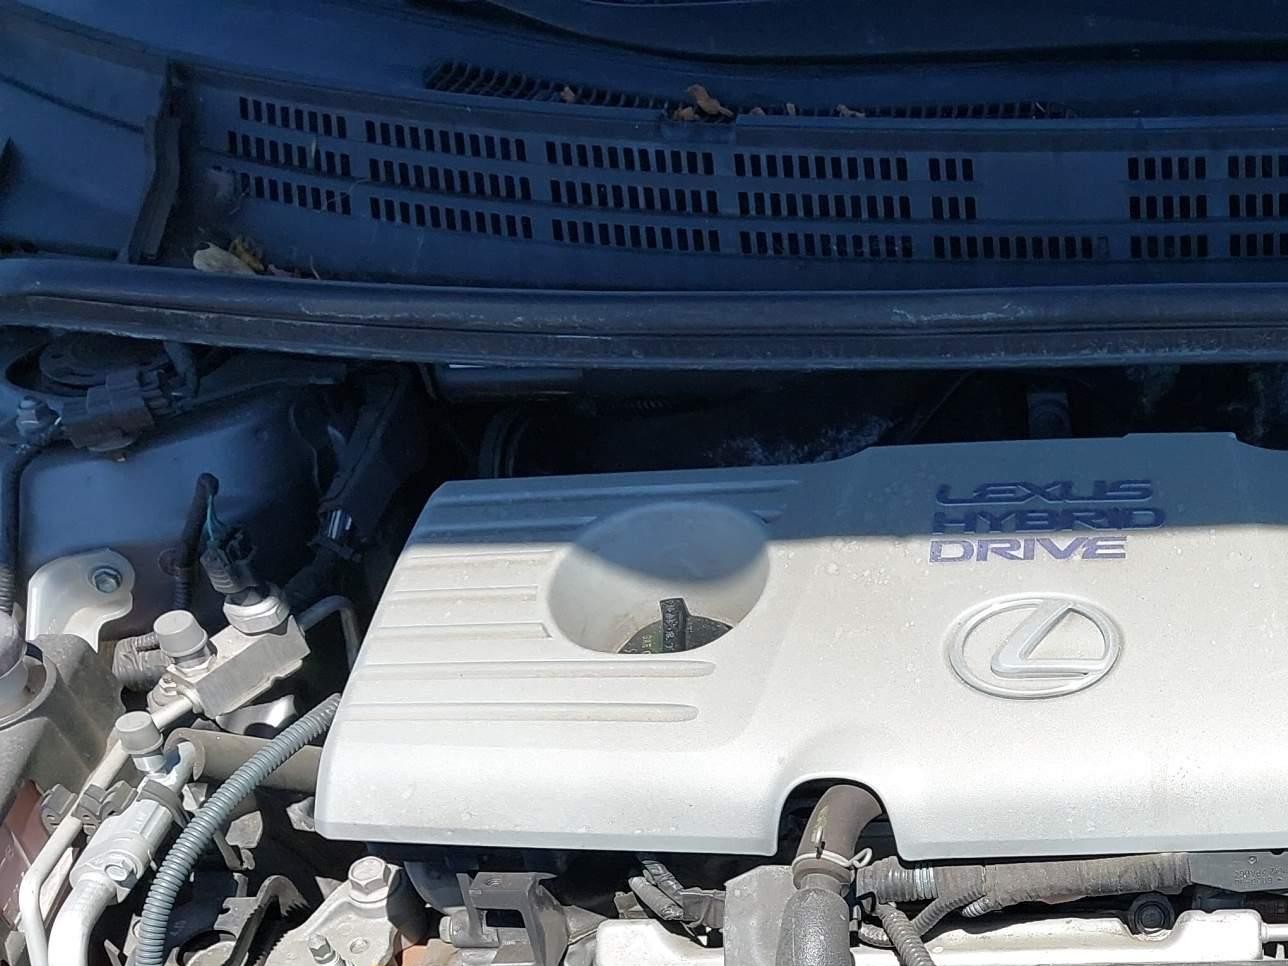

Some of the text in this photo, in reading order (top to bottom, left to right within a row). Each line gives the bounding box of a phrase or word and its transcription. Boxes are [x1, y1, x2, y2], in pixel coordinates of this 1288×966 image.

[935, 479, 1154, 505] LEXUS
[930, 507, 1168, 535] HYBRID
[928, 535, 1128, 564] DRIVE
